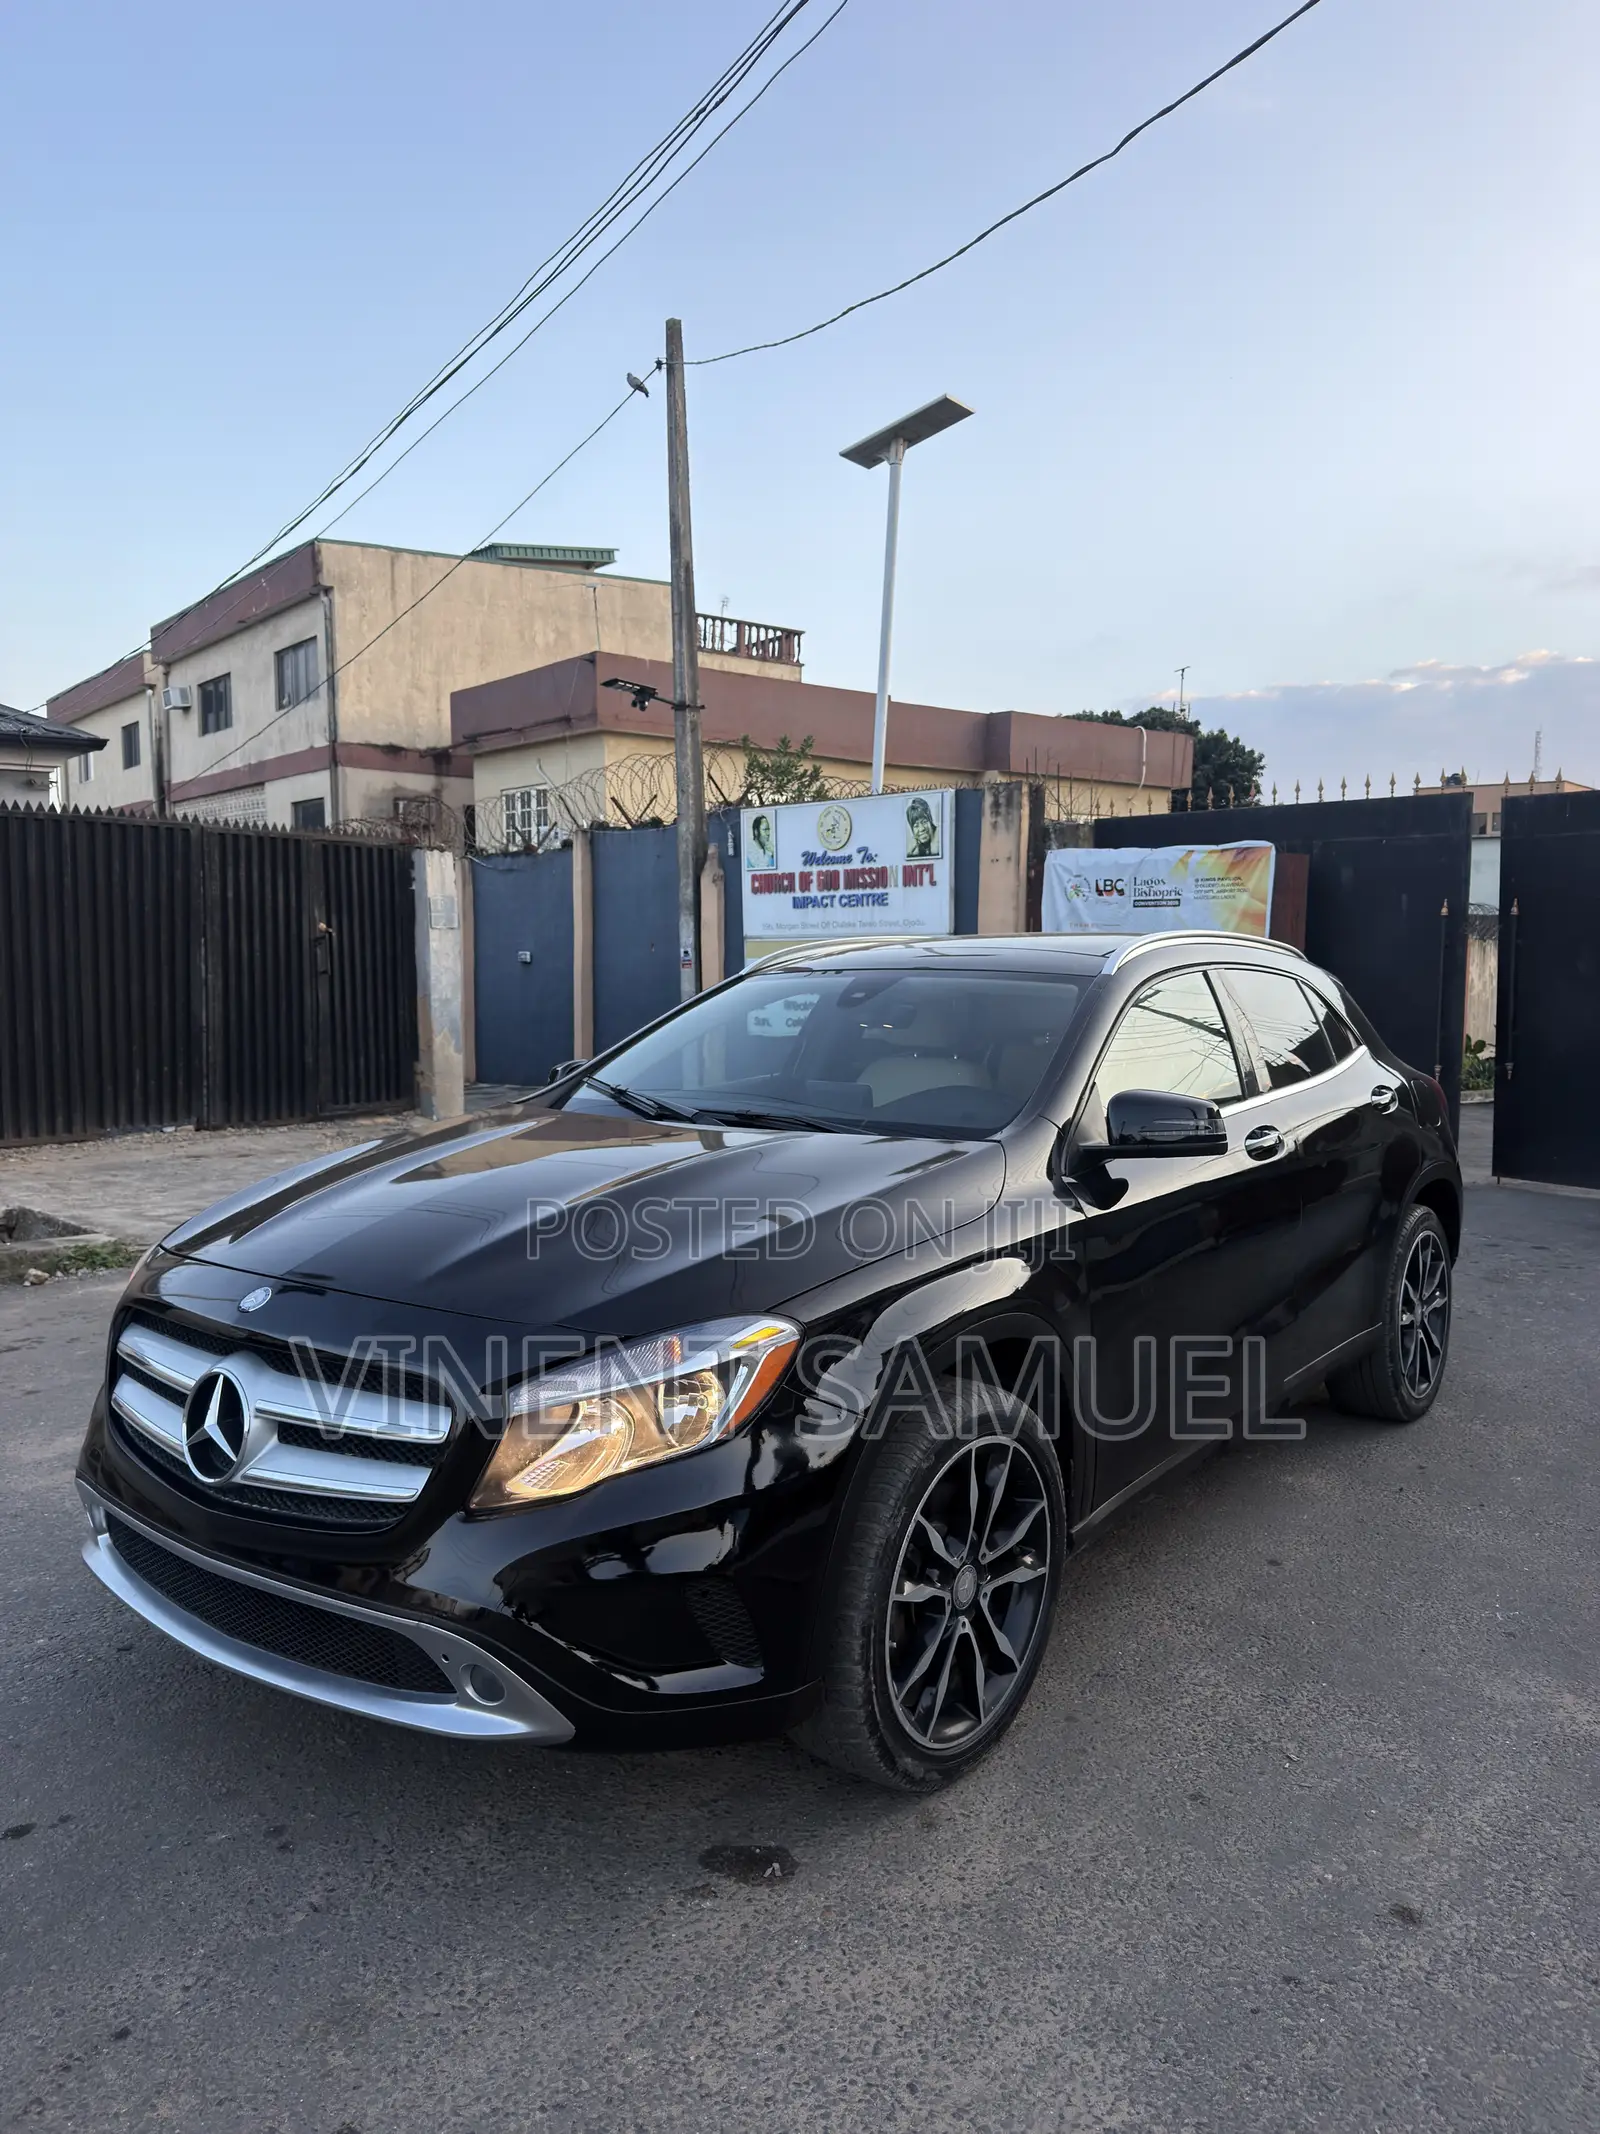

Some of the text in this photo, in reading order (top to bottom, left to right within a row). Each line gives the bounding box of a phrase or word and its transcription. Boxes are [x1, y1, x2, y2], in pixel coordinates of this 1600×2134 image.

[801, 846, 878, 867] Welcome To:
[751, 863, 937, 895] CHURCH OF GOD MISSION INT'L
[1095, 879, 1126, 897] LBC
[1133, 876, 1166, 888] Lagos
[792, 891, 889, 910] IMPACT CENTRE
[1133, 887, 1183, 899] Bishopric
